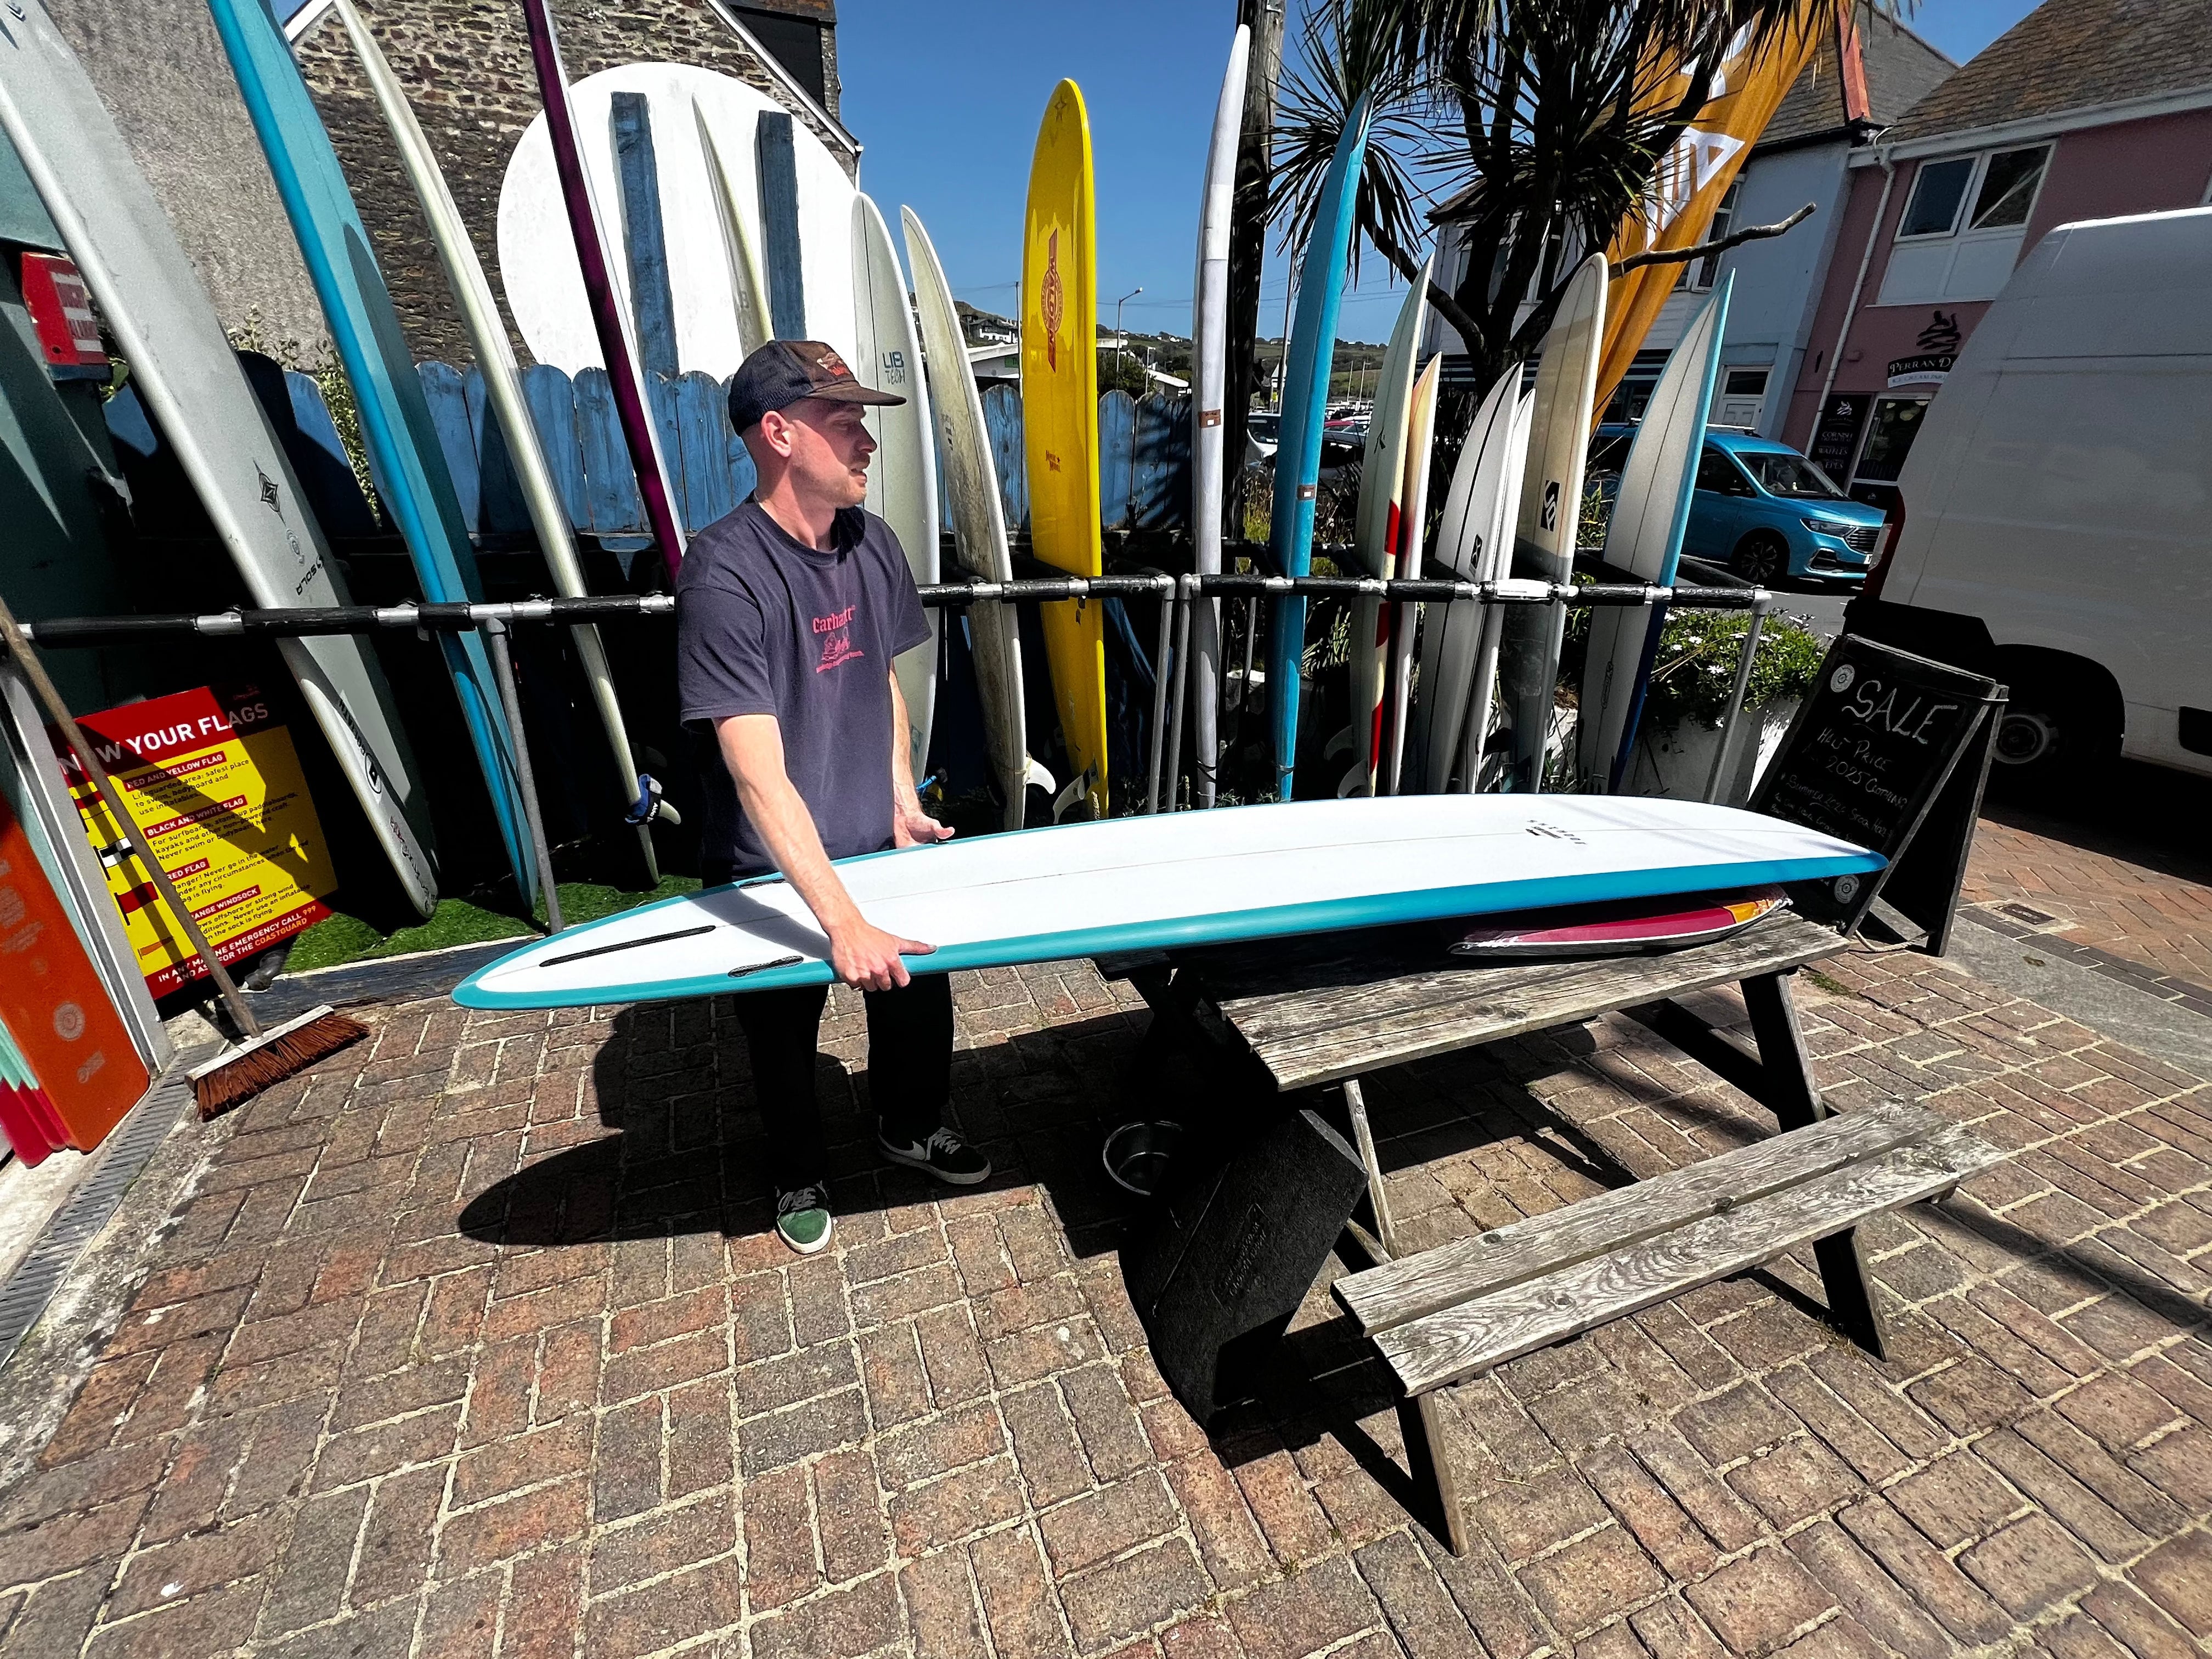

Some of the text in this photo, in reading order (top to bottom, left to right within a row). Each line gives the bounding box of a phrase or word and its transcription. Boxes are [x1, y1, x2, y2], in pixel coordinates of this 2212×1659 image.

[882, 352, 904, 368] LIB
[1890, 360, 1936, 373] PERRAN
[296, 564, 317, 596] SOLA
[813, 607, 852, 634] Carhatt
[1842, 680, 1958, 744] SALE
[125, 723, 196, 755] YOUR
[198, 702, 268, 736] FLAGS
[127, 755, 223, 789] RED AND YELLOW FLAG
[205, 766, 228, 777] safest
[230, 759, 249, 770] place
[215, 774, 229, 782] and
[1825, 755, 1871, 784] 2025
[139, 807, 154, 815] use
[147, 798, 244, 836] BLACK AND WHITE FLAG
[155, 840, 184, 854] kayaks
[185, 836, 200, 844] and
[201, 827, 222, 837] other
[159, 849, 183, 860] Never
[185, 842, 205, 852] swim
[167, 861, 206, 881] RED FLAG
[176, 875, 202, 889] anger!
[204, 866, 225, 878] Never
[228, 862, 236, 871] go
[246, 854, 258, 864] the
[259, 845, 279, 855] water
[178, 884, 198, 896] nder
[200, 881, 212, 890] any
[213, 859, 265, 882] circumstances
[201, 883, 224, 895] flying.
[191, 889, 258, 920] ANGE WINDSOCK
[198, 919, 212, 929] ows
[213, 905, 244, 923] offshore
[254, 891, 276, 904] strong
[278, 883, 294, 894] wind
[203, 921, 228, 935] ditions.
[233, 909, 251, 921] Never
[253, 902, 268, 911] use
[214, 928, 225, 938] the
[228, 921, 244, 931] sock
[253, 908, 274, 921] flying.
[159, 973, 170, 982] IN
[172, 962, 190, 977] ANY
[229, 923, 280, 951] EMERGENCY
[281, 912, 302, 927] CALL
[303, 905, 317, 916] 999
[176, 917, 307, 984] AND AS FOR THE COASTGUARD
